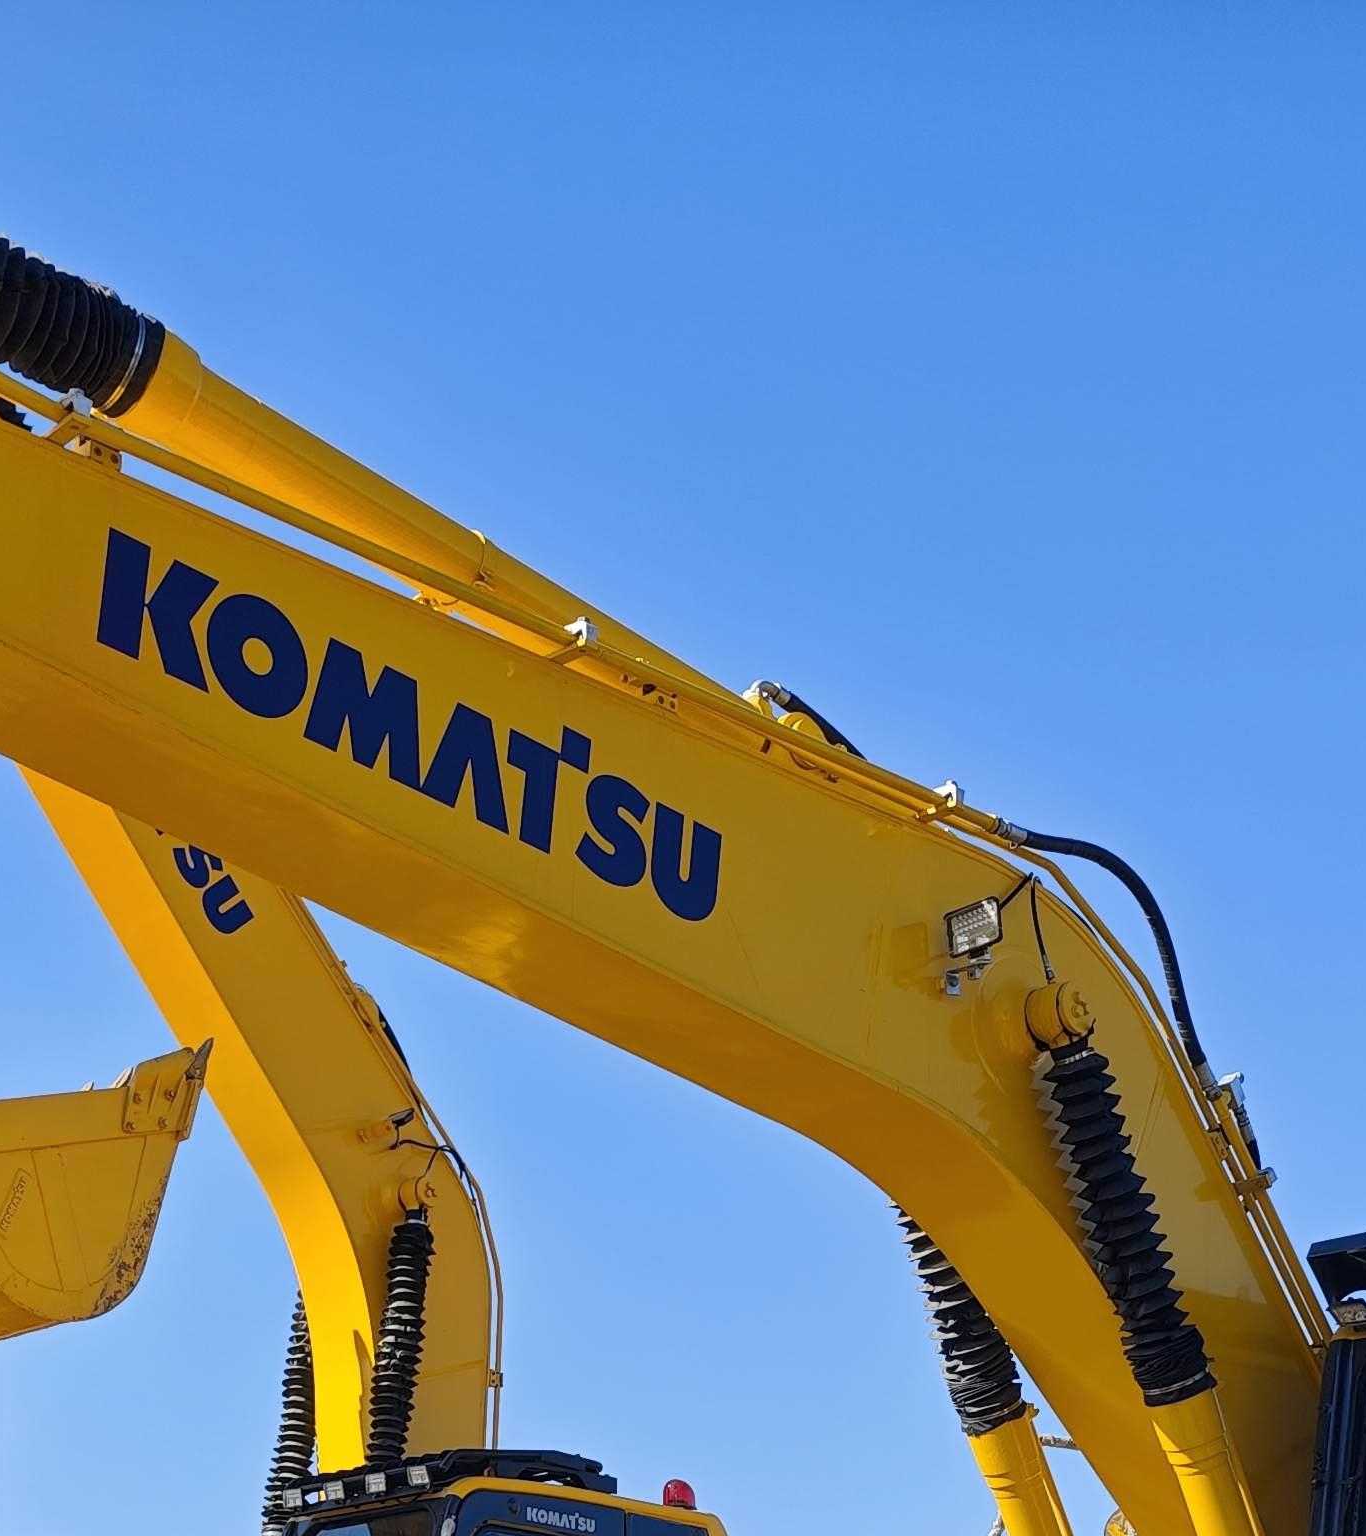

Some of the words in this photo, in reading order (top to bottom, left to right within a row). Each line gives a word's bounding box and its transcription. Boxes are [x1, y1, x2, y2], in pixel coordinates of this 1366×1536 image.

[96, 527, 722, 921] KOMATSU
[155, 828, 254, 934] SU
[525, 1506, 597, 1534] KOMATSU
